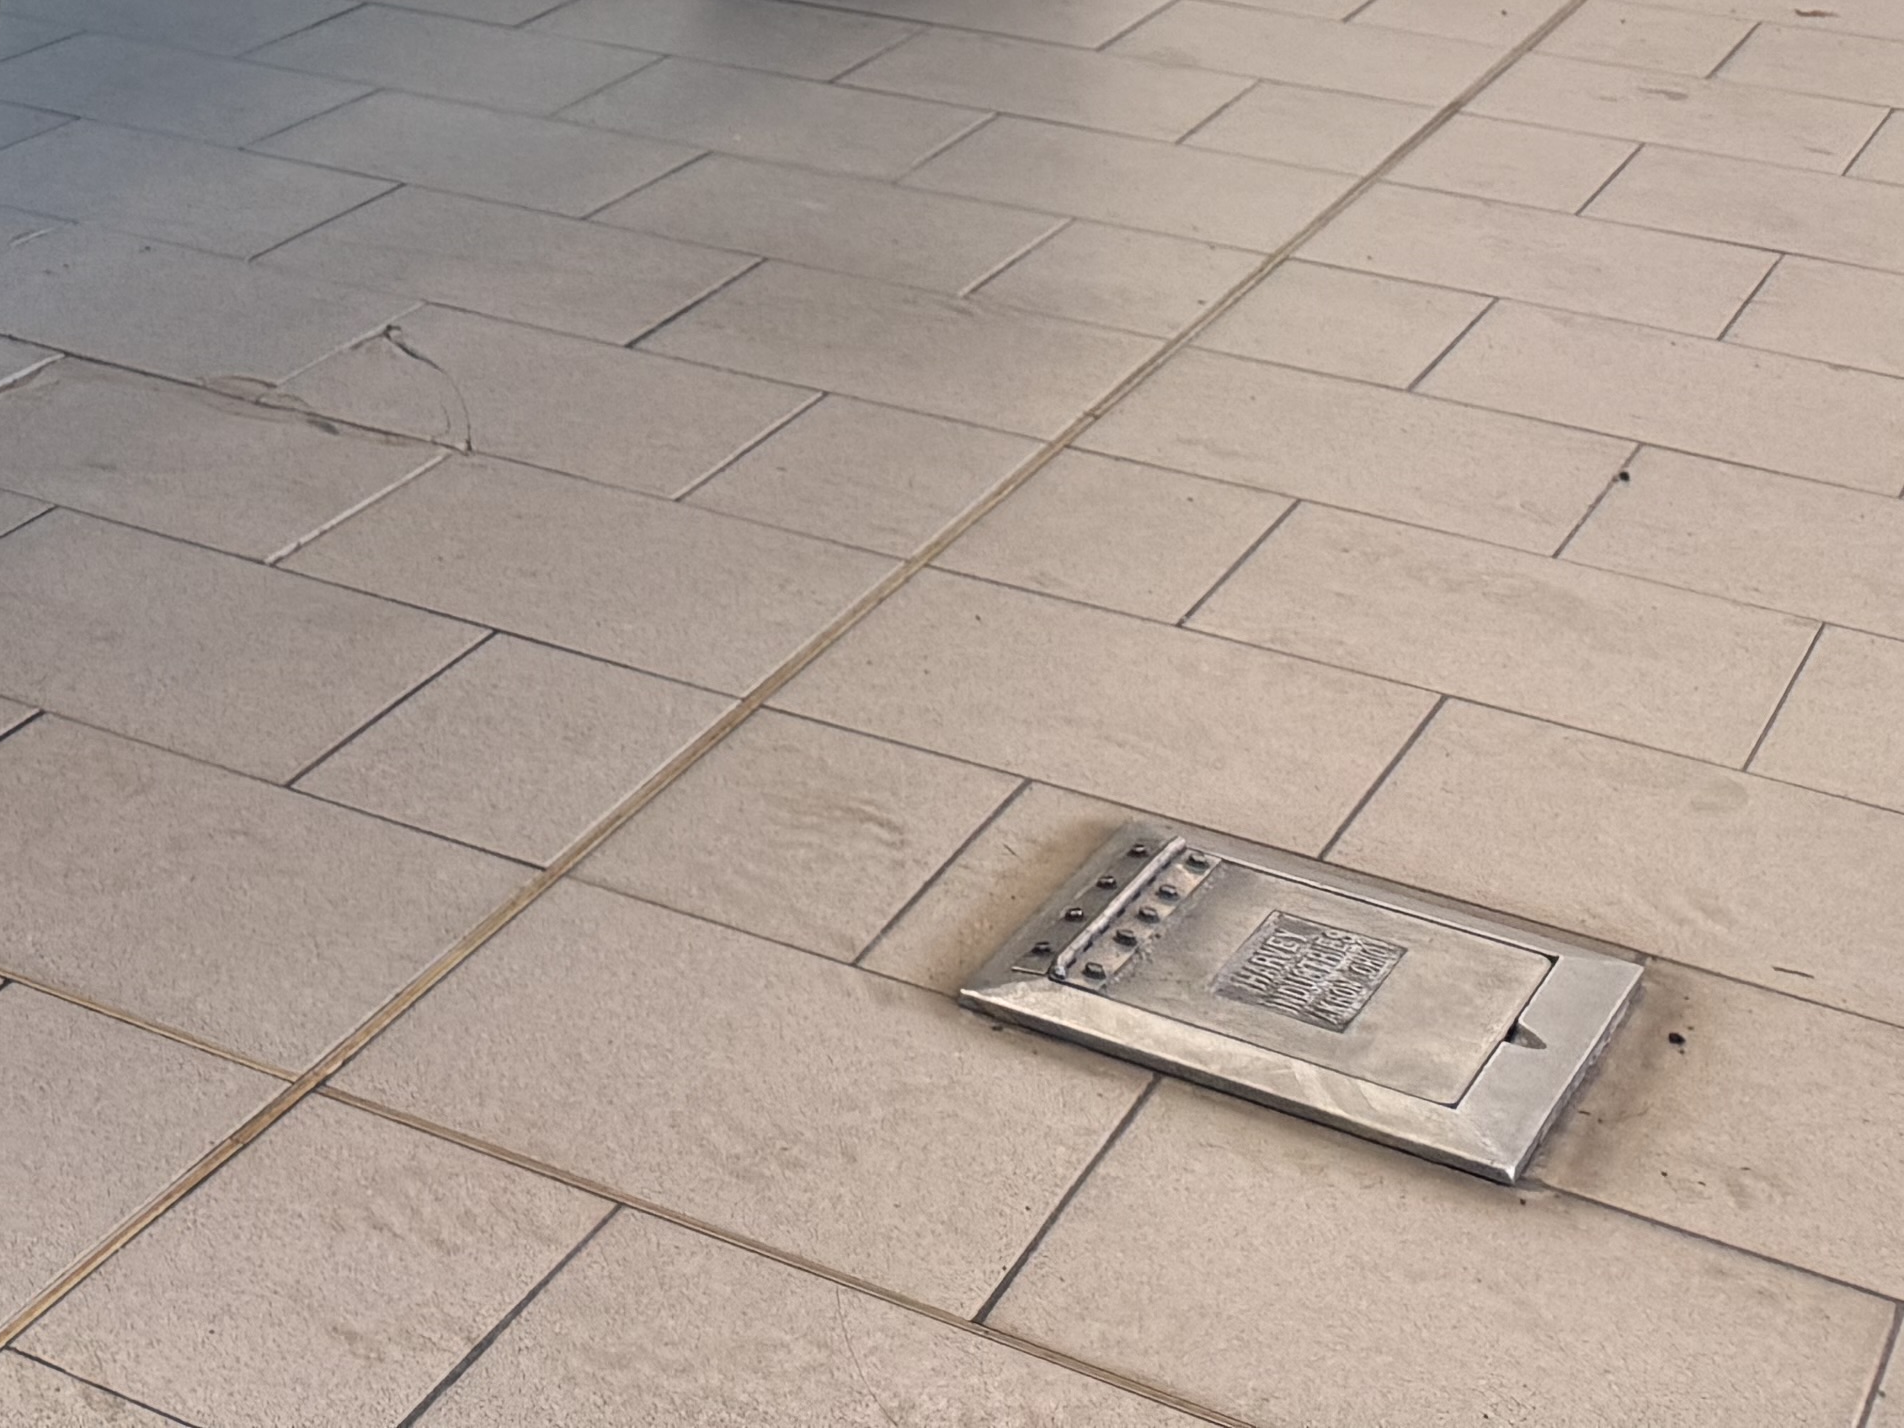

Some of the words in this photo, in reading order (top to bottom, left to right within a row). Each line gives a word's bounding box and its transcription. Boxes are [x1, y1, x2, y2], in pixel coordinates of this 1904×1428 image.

[1235, 928, 1307, 990] HARVEY
[1261, 929, 1356, 1014] INDUSTRIES
[1307, 975, 1366, 1023] AKRON
